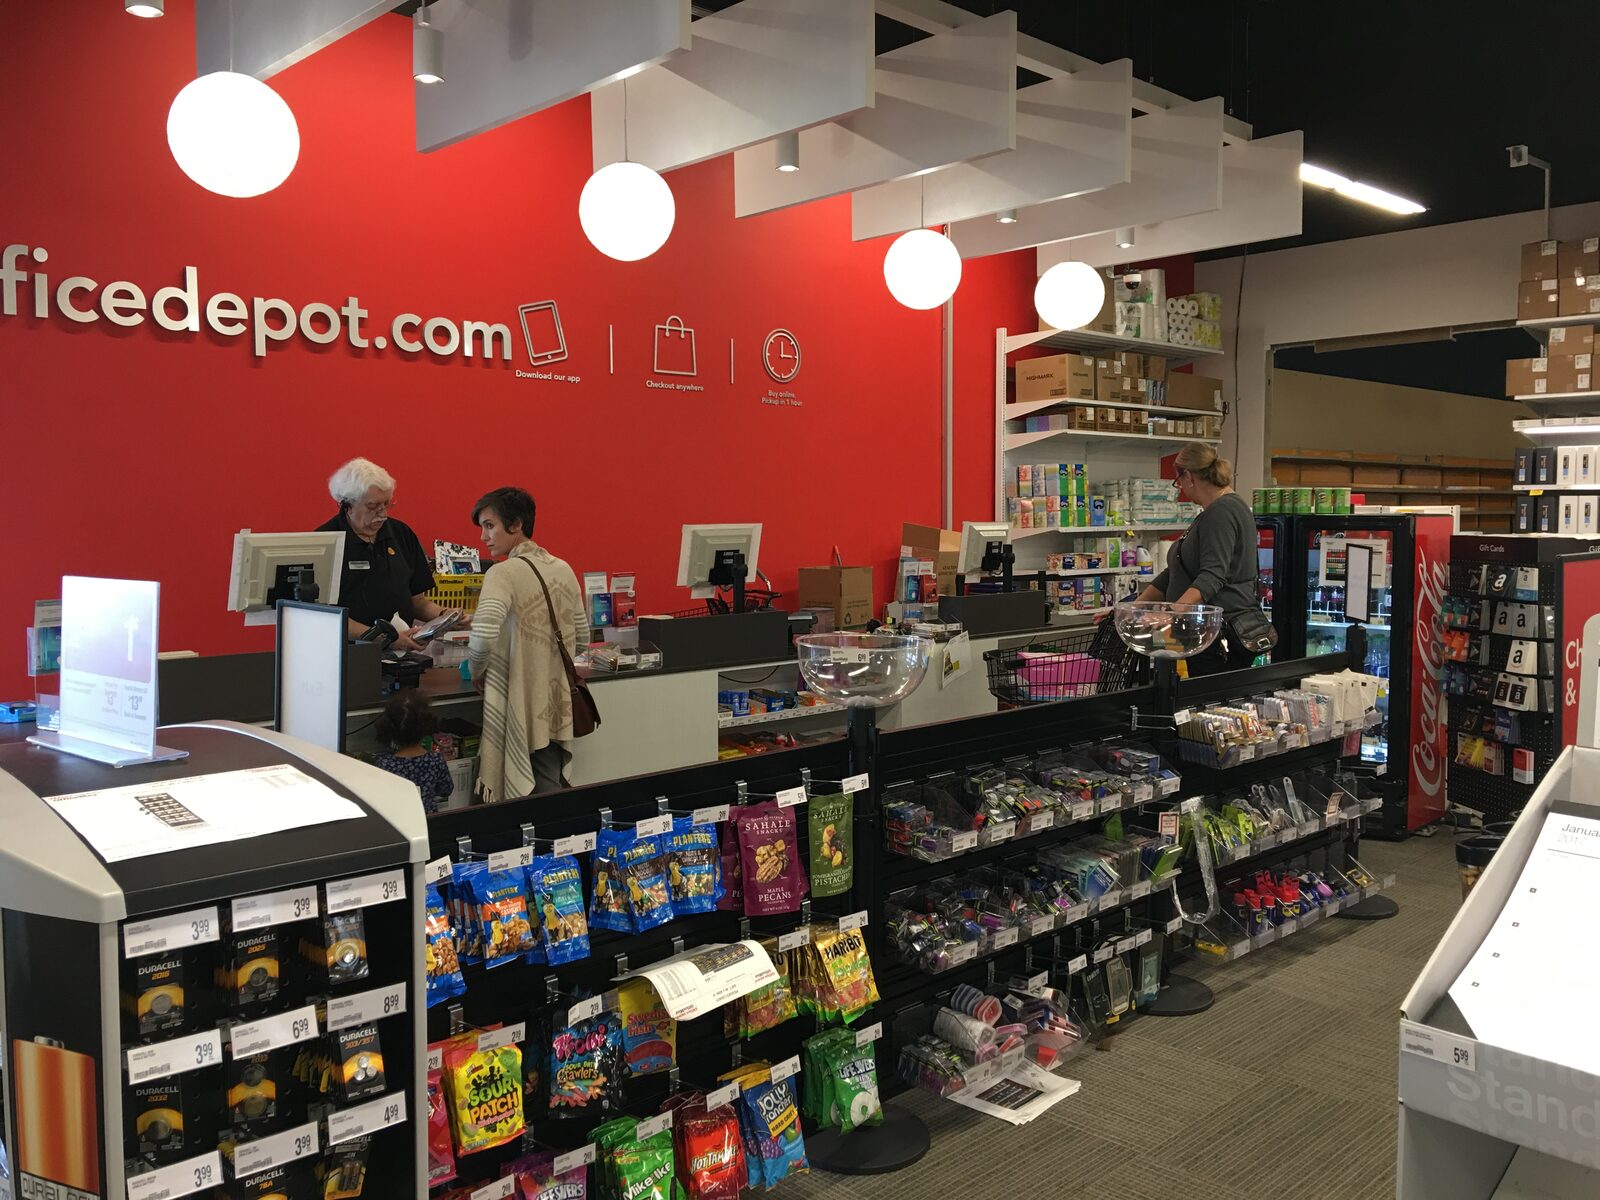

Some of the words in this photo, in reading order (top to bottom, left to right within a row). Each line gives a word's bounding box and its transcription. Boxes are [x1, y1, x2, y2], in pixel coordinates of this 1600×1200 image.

[0, 244, 513, 363] ficedepot.com
[515, 369, 552, 380] Download
[567, 375, 581, 384] app
[646, 380, 675, 390] Checkout
[676, 383, 704, 392] anywhere
[767, 389, 778, 399] Buy
[1479, 544, 1490, 552] Gift
[1490, 544, 1505, 553] Cards
[1565, 678, 1577, 707] &
[745, 819, 791, 832] SAHALE
[673, 833, 711, 847] PLANTERS
[624, 844, 656, 862] PLANTERS
[382, 880, 398, 899] 399
[758, 891, 792, 903] PECANS
[294, 897, 310, 917] 399
[192, 919, 209, 940] 399
[237, 933, 276, 949] DURACELL
[824, 935, 862, 961] HARIBO
[138, 960, 182, 976] DURACELL
[384, 994, 399, 1014] 899
[292, 1018, 309, 1039] 699
[340, 1028, 377, 1043] DURACELL
[628, 1022, 653, 1037] Fish
[552, 1023, 605, 1061] Trolli
[195, 1042, 213, 1064] 399
[1454, 1047, 1469, 1063] 599
[565, 1061, 582, 1071] SOUR
[557, 1067, 599, 1085] Crawlers
[136, 1086, 180, 1097] DURACELL
[469, 1078, 514, 1107] SOUR
[757, 1082, 788, 1116] JOLLY
[384, 1104, 399, 1124] 499
[469, 1090, 519, 1126] PATCH
[765, 1095, 792, 1123] rancher
[295, 1135, 311, 1156] 399
[691, 1156, 708, 1174] HOT
[194, 1165, 212, 1187] 399
[245, 1169, 284, 1188] DURACELL
[623, 1177, 653, 1200] Mike
[654, 1161, 672, 1181] Ike
